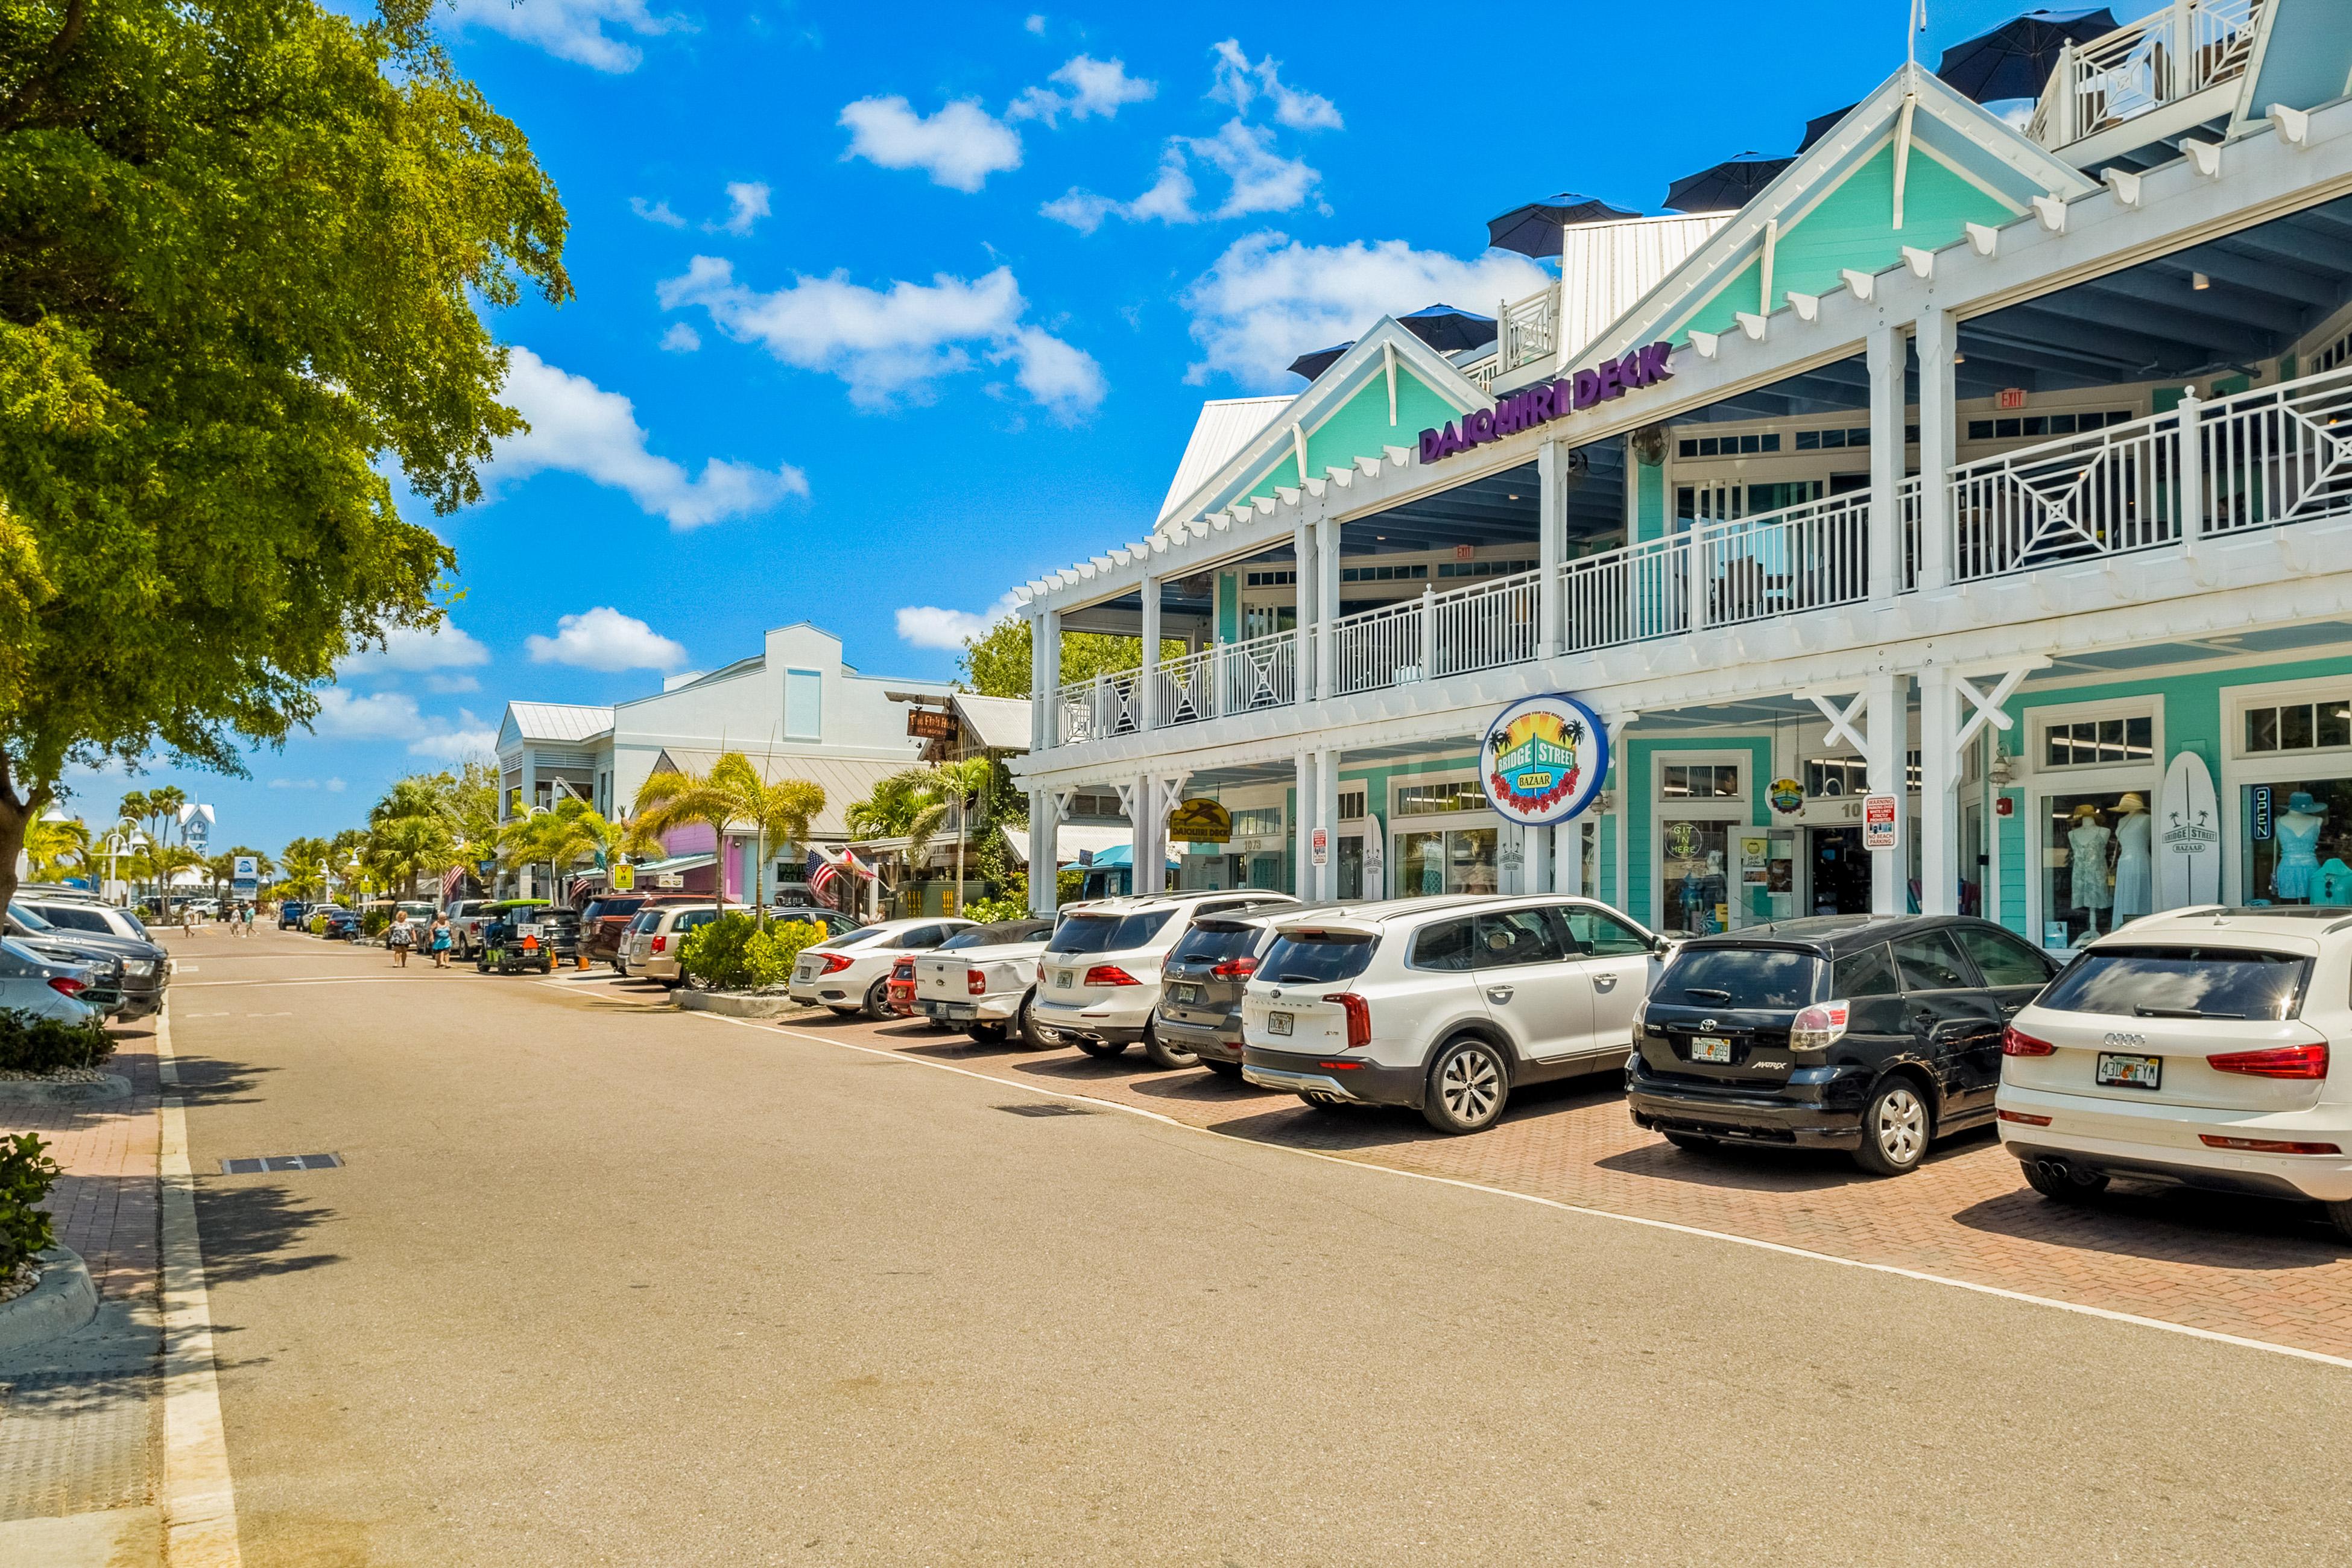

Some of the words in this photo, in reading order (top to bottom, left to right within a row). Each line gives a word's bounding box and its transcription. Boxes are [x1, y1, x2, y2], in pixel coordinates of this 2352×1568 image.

[1418, 378, 1571, 464] DAIQUIRI
[1573, 341, 1675, 410] DECK
[2002, 391, 2023, 406] EXIT
[1457, 546, 1470, 558] EXIT
[925, 714, 940, 727] Fish
[1505, 712, 1531, 729] EVERYTHING
[1551, 712, 1566, 722] BEACH
[1497, 743, 1531, 773] BRIDGE
[1538, 742, 1574, 766] STREET
[1519, 775, 1550, 786] BAZAAR
[1841, 803, 1861, 818] 10
[2257, 790, 2268, 836] OPEN
[1172, 827, 1208, 836] DAIQUIRI
[2164, 829, 2187, 841] BRIDGE
[2191, 829, 2215, 840] STREET
[785, 873, 805, 882] GOLF
[1751, 1061, 1788, 1070] MATRIX
[2134, 1064, 2155, 1080] FYM
